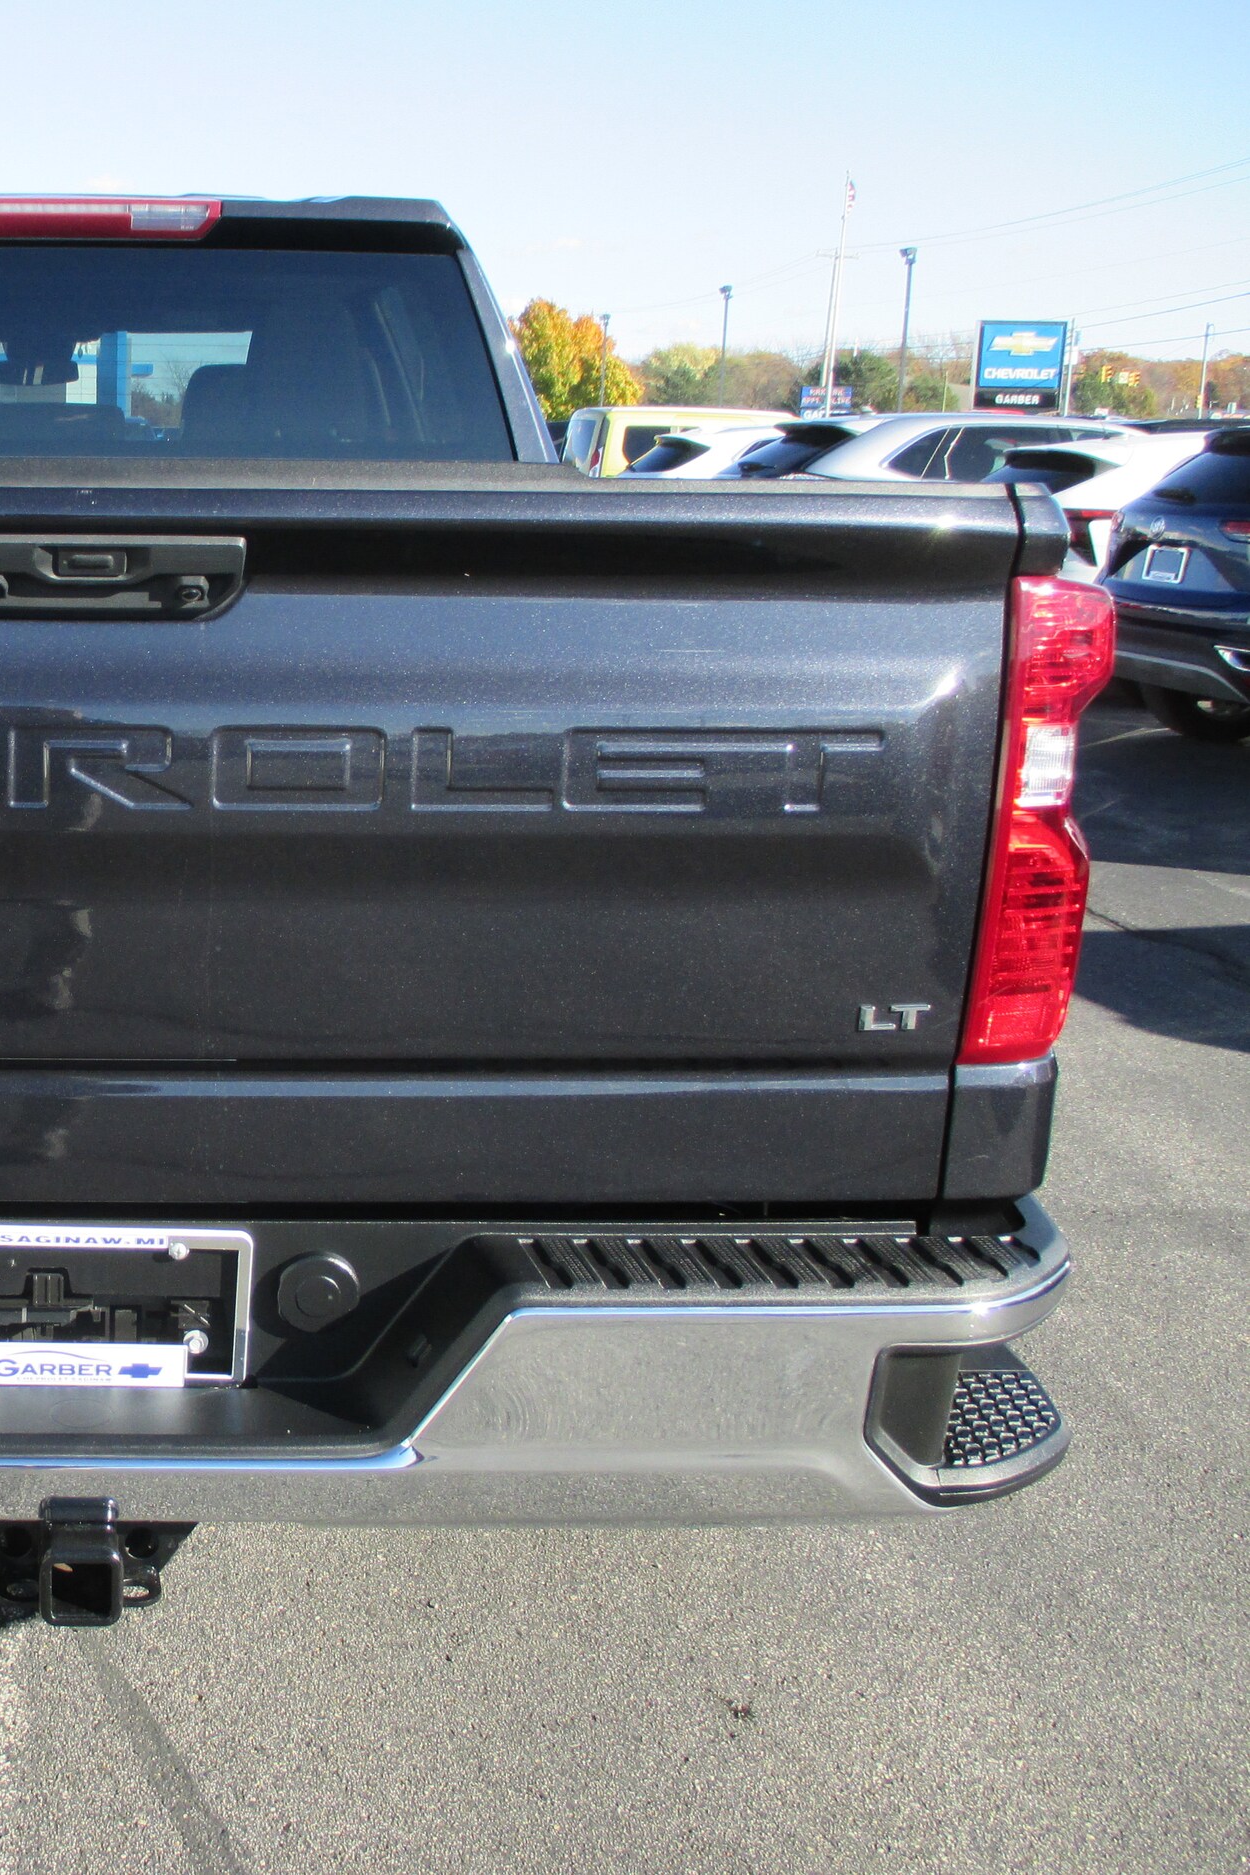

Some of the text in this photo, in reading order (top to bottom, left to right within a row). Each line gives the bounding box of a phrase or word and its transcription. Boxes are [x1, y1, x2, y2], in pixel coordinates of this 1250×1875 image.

[983, 367, 1058, 379] CHEVROLET
[994, 394, 1040, 405] GARBER
[858, 1004, 931, 1031] LT
